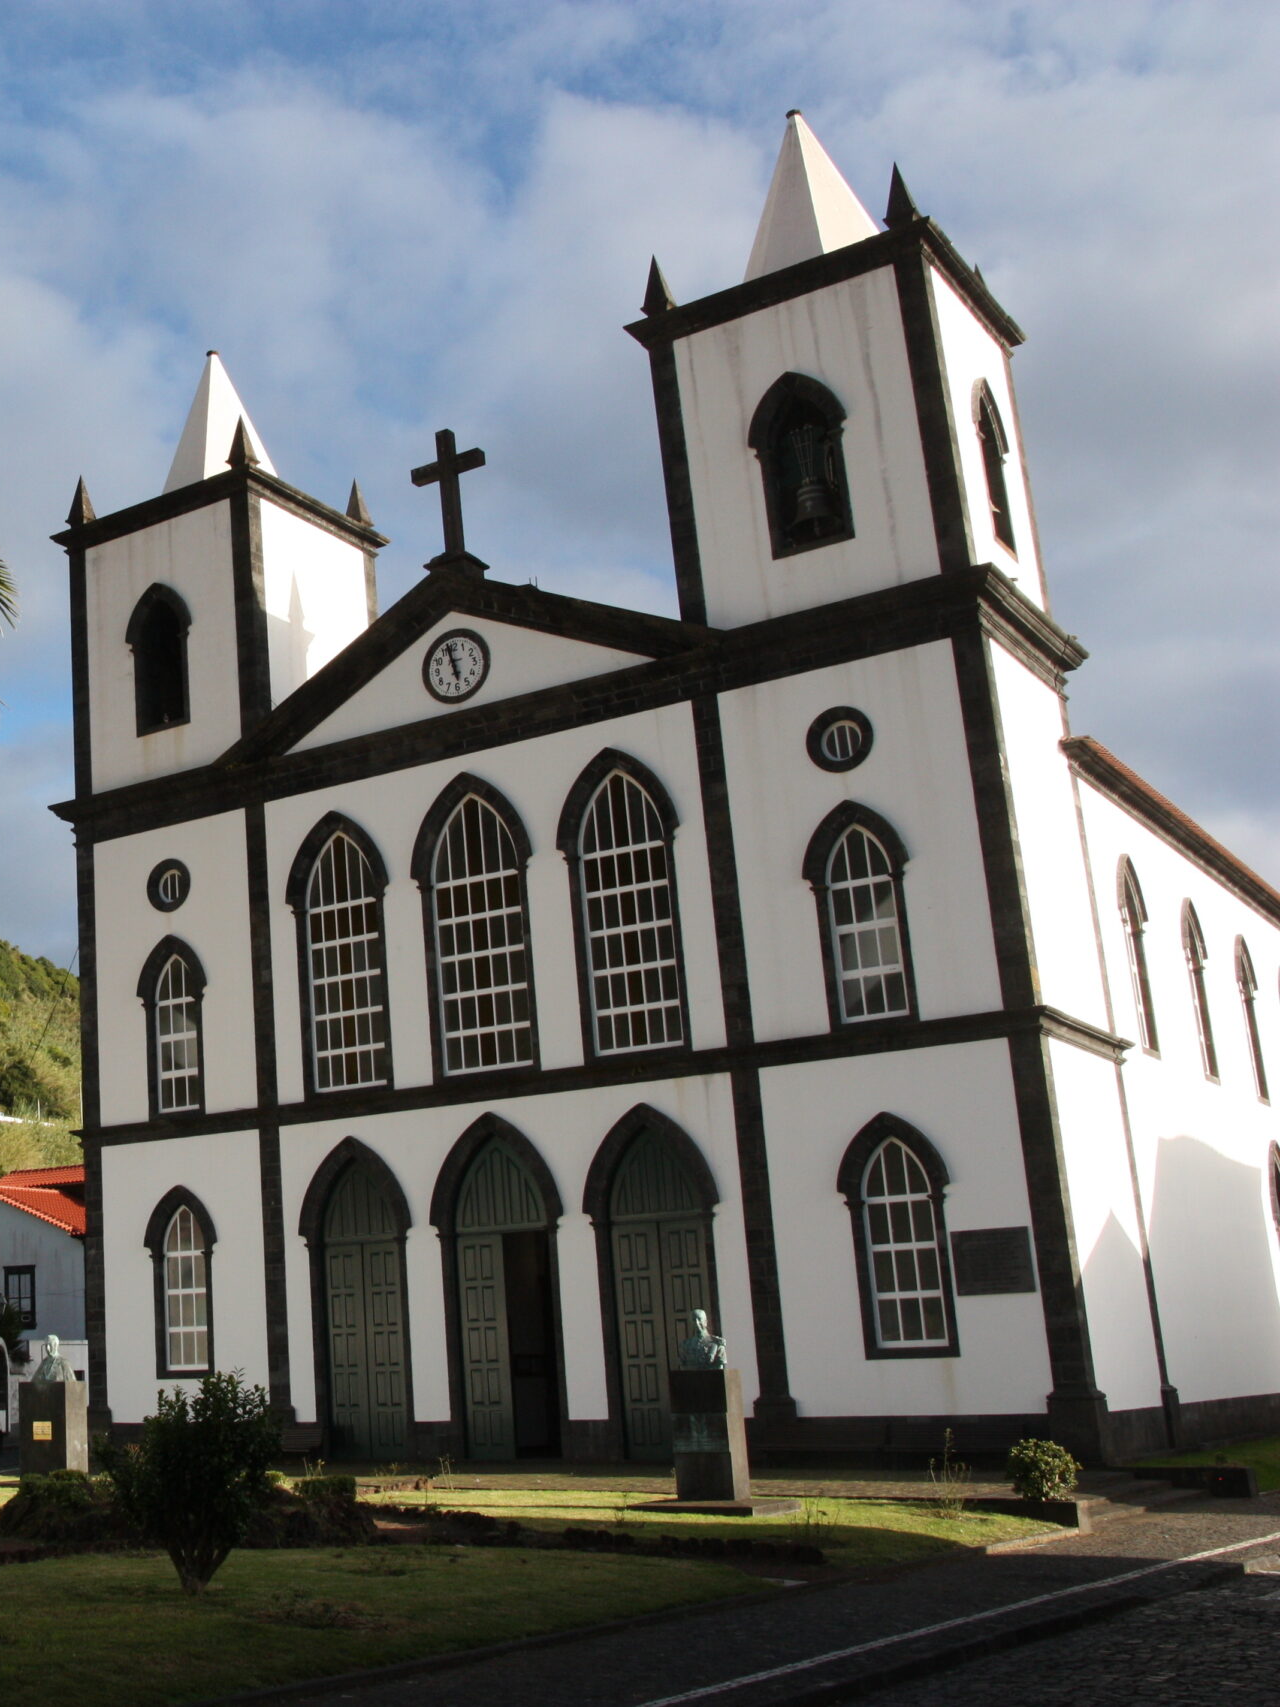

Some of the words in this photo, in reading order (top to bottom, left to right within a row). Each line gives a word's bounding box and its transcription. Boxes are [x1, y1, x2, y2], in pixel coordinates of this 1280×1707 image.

[461, 642, 464, 651] 1
[468, 648, 474, 657] 2
[435, 657, 442, 666] 10
[472, 657, 477, 665] 3
[435, 668, 440, 676] 9
[439, 677, 443, 686] 8
[464, 677, 470, 686] 5
[446, 682, 451, 692] 7
[455, 683, 460, 691] 6
